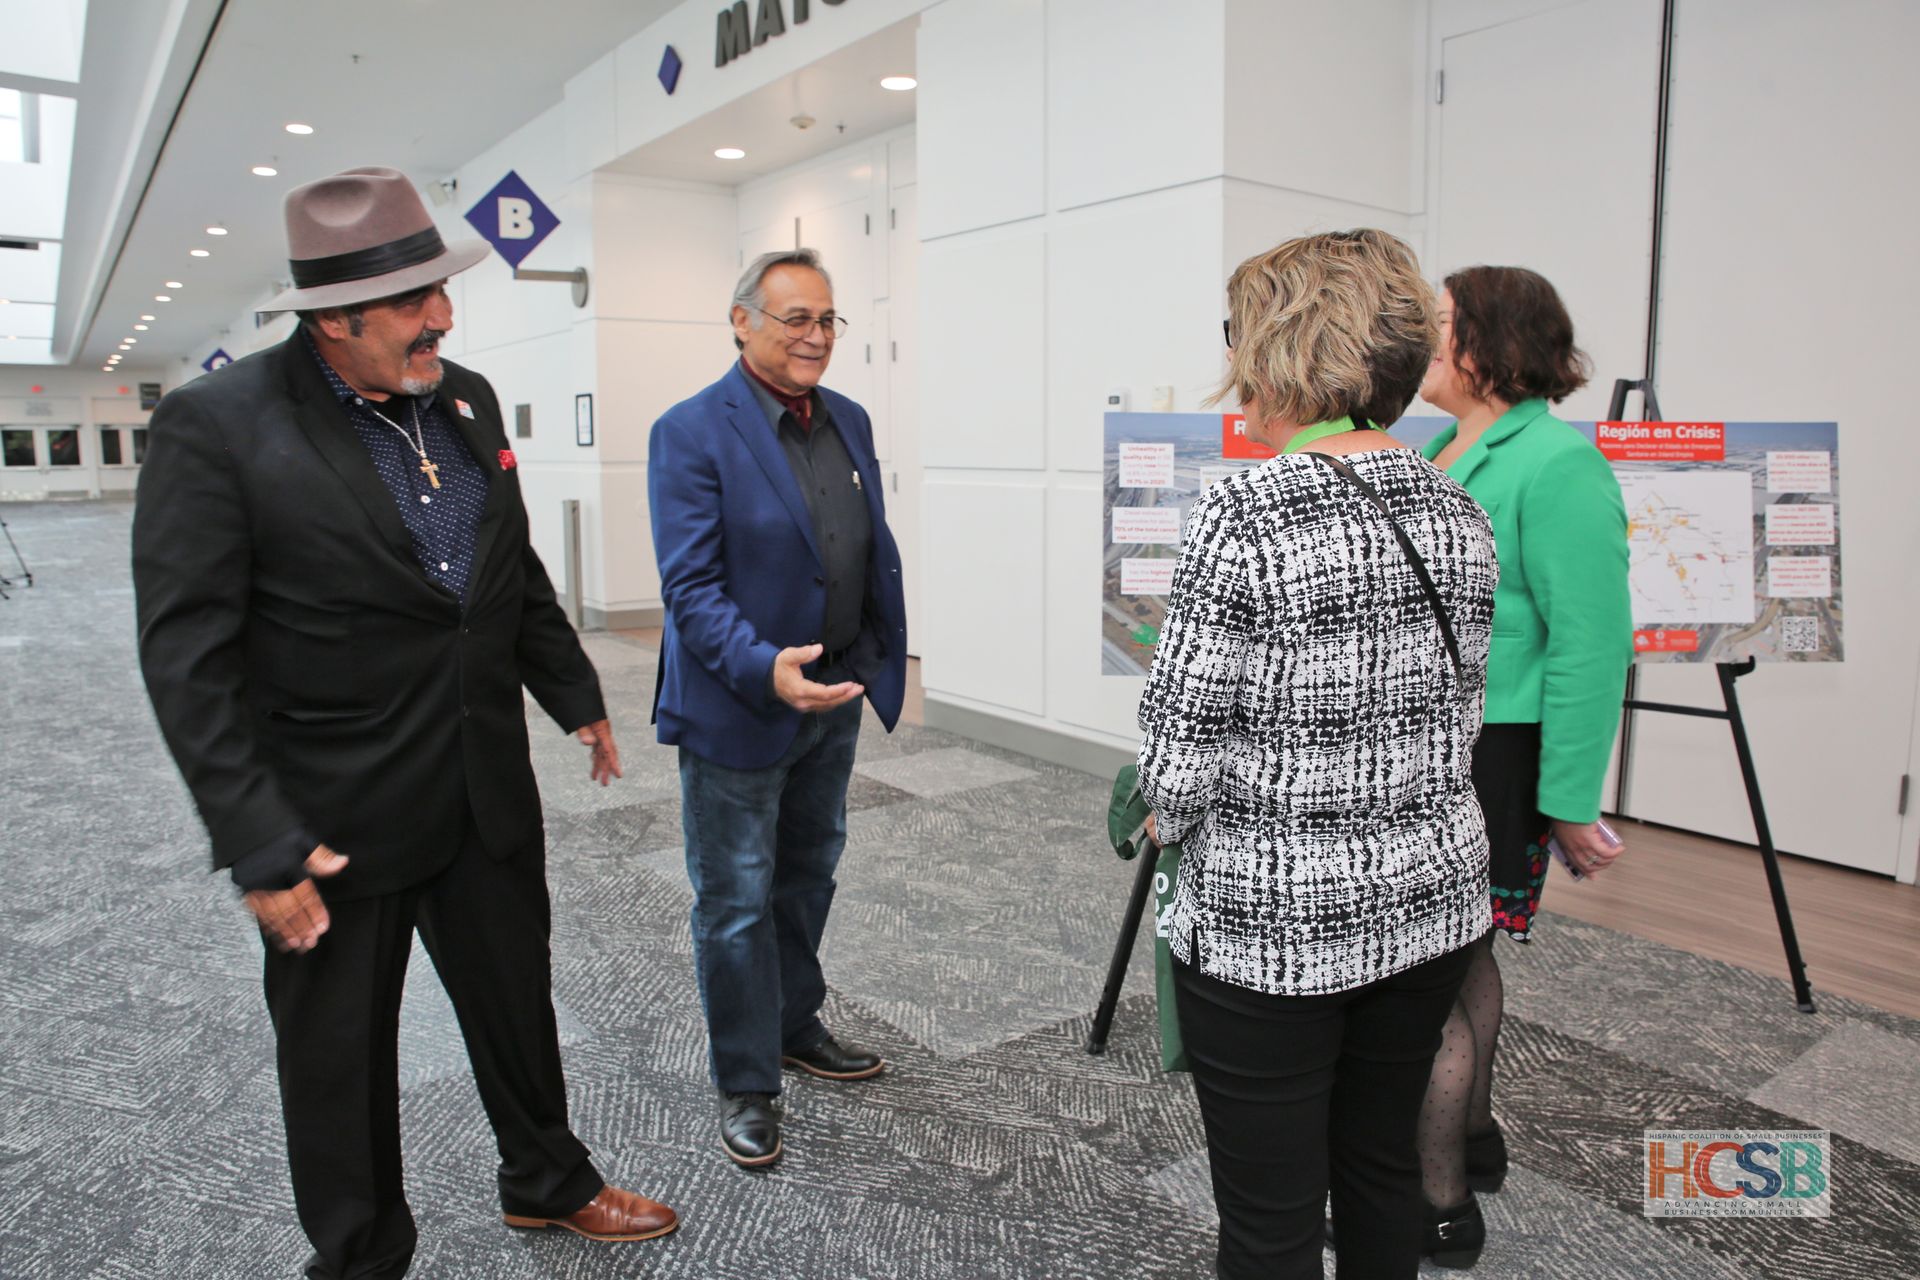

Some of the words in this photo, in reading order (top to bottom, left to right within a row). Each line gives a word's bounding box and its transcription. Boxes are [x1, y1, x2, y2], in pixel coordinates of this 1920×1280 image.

[497, 196, 535, 240] B
[1599, 424, 1650, 441] Región
[1653, 428, 1672, 439] en
[1675, 425, 1721, 439] Crisis:
